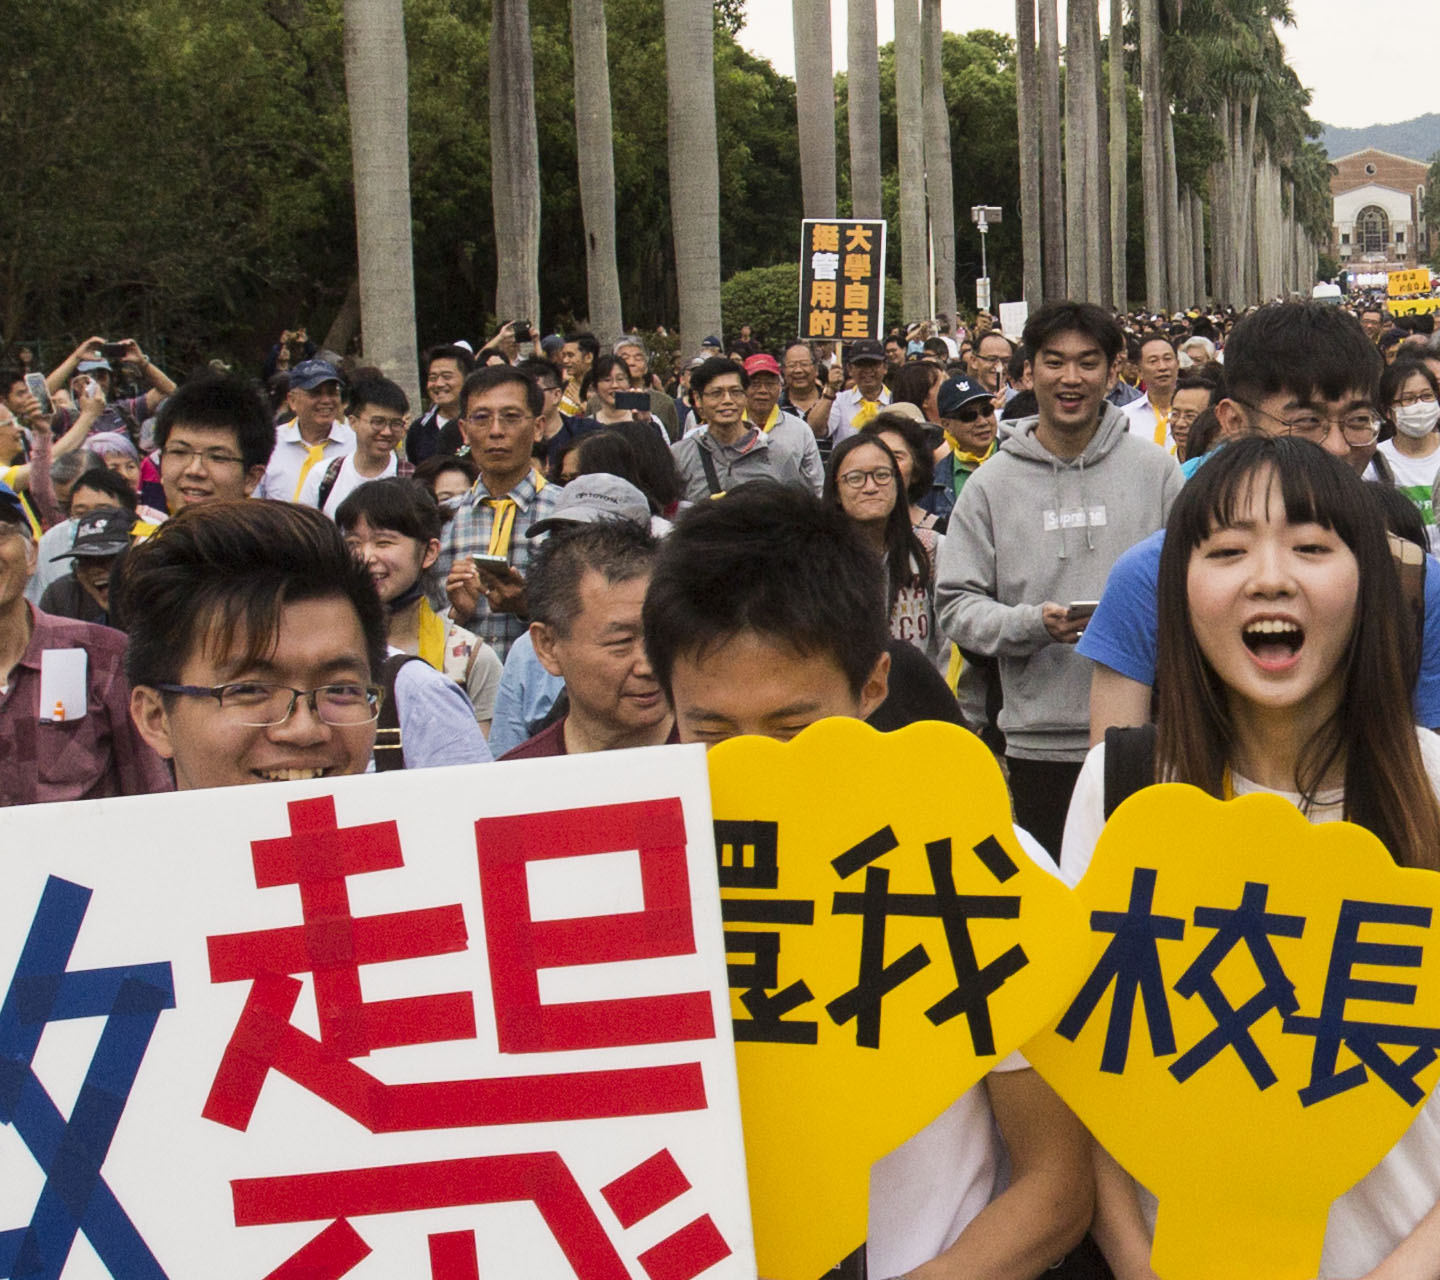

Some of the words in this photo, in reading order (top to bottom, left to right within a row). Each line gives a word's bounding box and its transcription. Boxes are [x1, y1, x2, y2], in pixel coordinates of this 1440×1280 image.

[809, 223, 840, 337] 挺管用的
[842, 224, 873, 338] 大學自主
